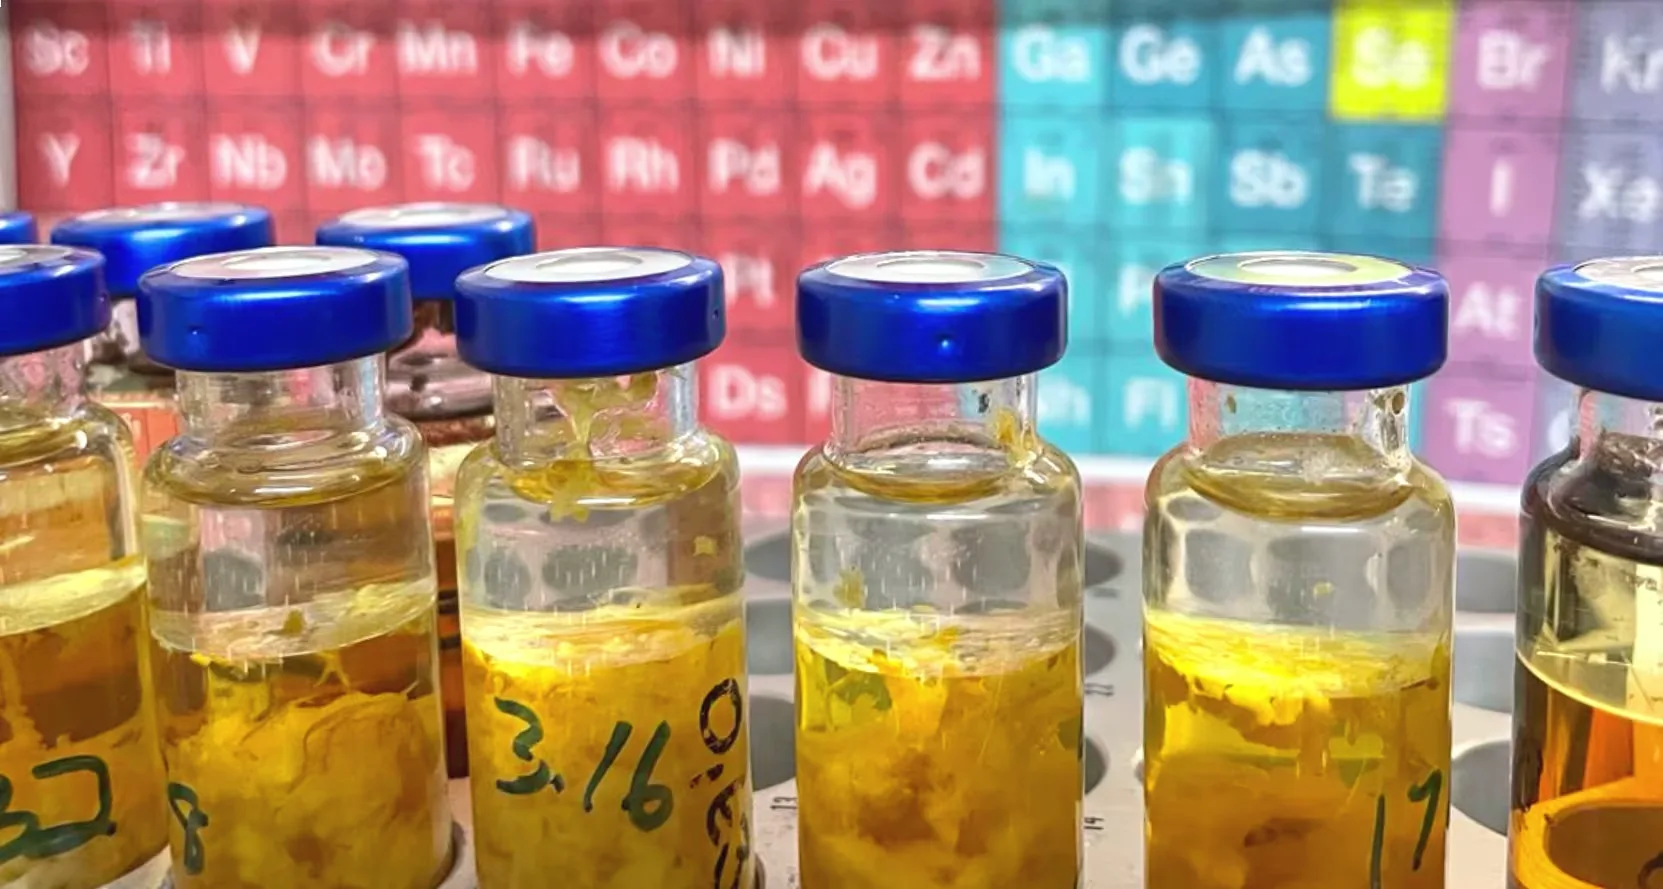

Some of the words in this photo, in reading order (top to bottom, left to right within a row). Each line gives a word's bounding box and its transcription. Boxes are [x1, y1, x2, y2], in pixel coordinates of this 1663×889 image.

[223, 23, 262, 75] V
[313, 23, 376, 76] Cr
[397, 19, 478, 77] Mn
[506, 23, 575, 79] Fe
[602, 21, 677, 79] Co
[707, 23, 766, 79] Ni
[804, 24, 878, 80] Cu
[910, 26, 980, 81] Zn
[1011, 25, 1091, 83] Ga
[1118, 26, 1200, 85] Ge
[1233, 27, 1311, 86] As
[1477, 29, 1548, 91] Br
[39, 133, 79, 186] Y
[126, 133, 185, 188] Zr
[210, 133, 287, 190] Nb
[307, 136, 387, 190] Mo
[414, 134, 475, 191] Tc
[507, 136, 581, 192] Ru
[607, 137, 679, 191] Rh
[707, 138, 781, 194] Pd
[807, 141, 876, 207] Ag
[908, 142, 985, 199] Cd
[1022, 147, 1076, 200] In
[1230, 149, 1310, 208] Sb
[1348, 153, 1418, 213] Te
[1578, 162, 1662, 223] Xe
[1454, 282, 1522, 341] At
[708, 364, 788, 420] Ds
[1443, 397, 1517, 458] Ts
[494, 696, 673, 832] 3.16
